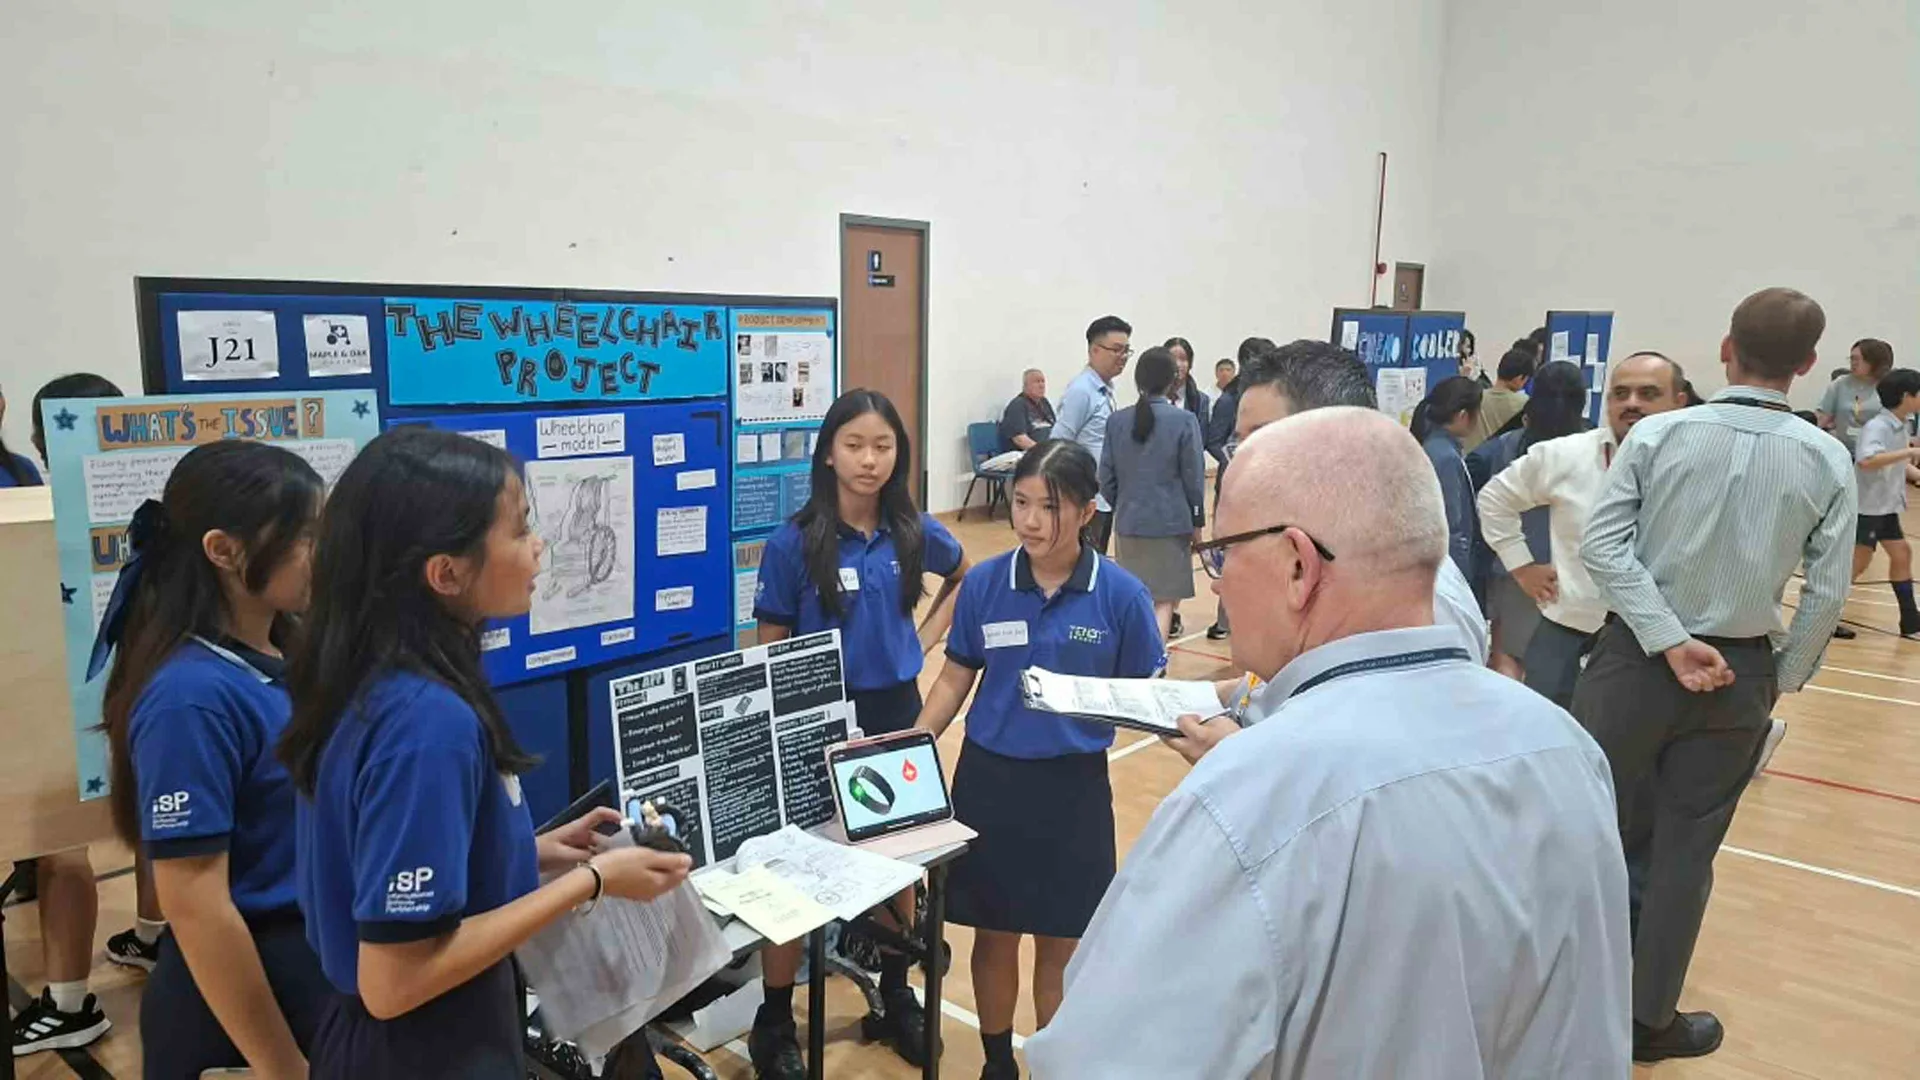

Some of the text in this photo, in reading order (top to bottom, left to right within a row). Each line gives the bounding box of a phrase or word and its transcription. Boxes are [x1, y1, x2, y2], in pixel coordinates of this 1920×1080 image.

[386, 302, 724, 351] THE WHEELCHAIR
[206, 336, 256, 368] J21
[309, 350, 337, 359] MAPLE
[495, 348, 661, 397] PROJECT
[101, 400, 321, 444] WHAT'S THE ISSUE ?
[539, 418, 622, 437] Wheelchair
[560, 436, 601, 452] model
[152, 791, 190, 812] iSP
[388, 866, 433, 892] iSP
